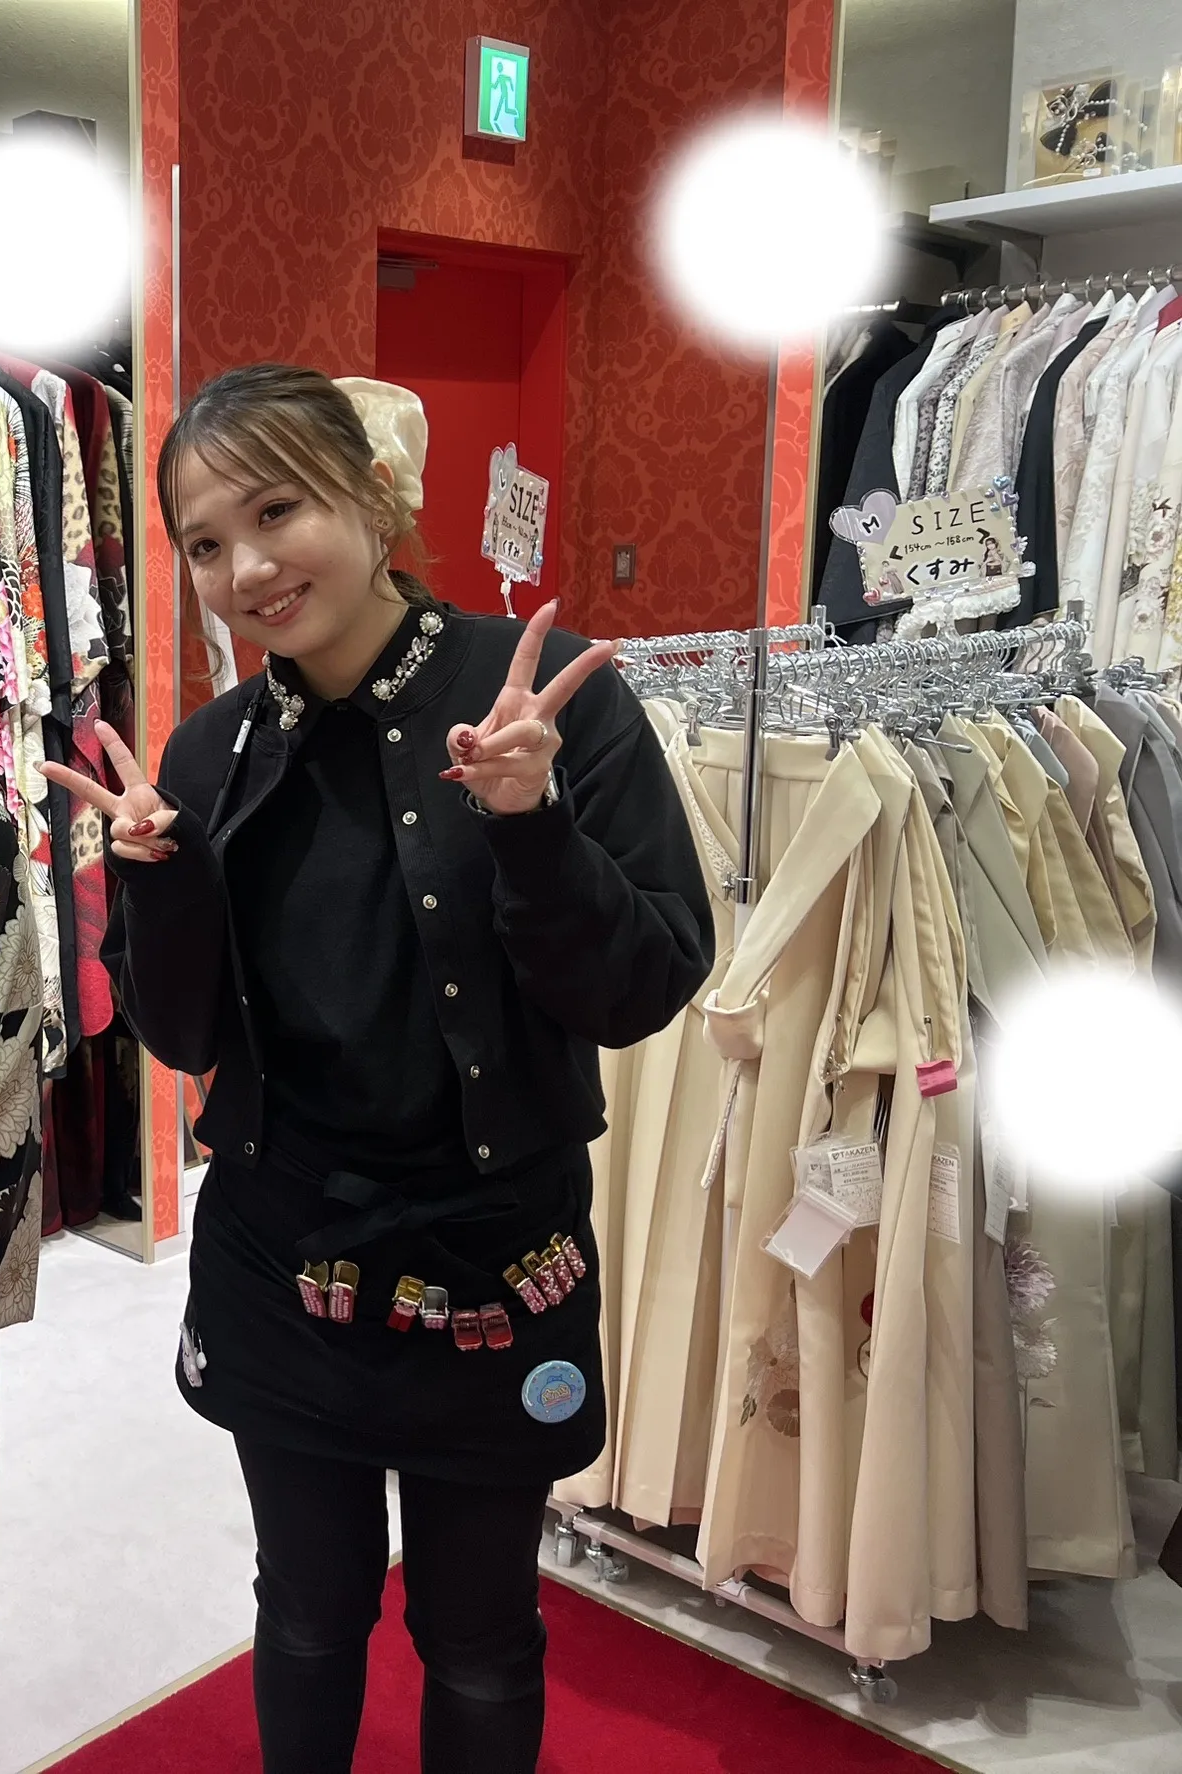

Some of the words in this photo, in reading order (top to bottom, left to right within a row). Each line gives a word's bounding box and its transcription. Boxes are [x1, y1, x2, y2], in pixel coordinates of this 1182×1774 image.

[499, 470, 506, 488] L
[509, 482, 539, 525] SIZE
[862, 514, 879, 534] M
[911, 500, 986, 535] SIZE
[907, 557, 975, 585] くすみ
[840, 1145, 876, 1158] TAKAZEN
[932, 1154, 955, 1167] KAZEN
